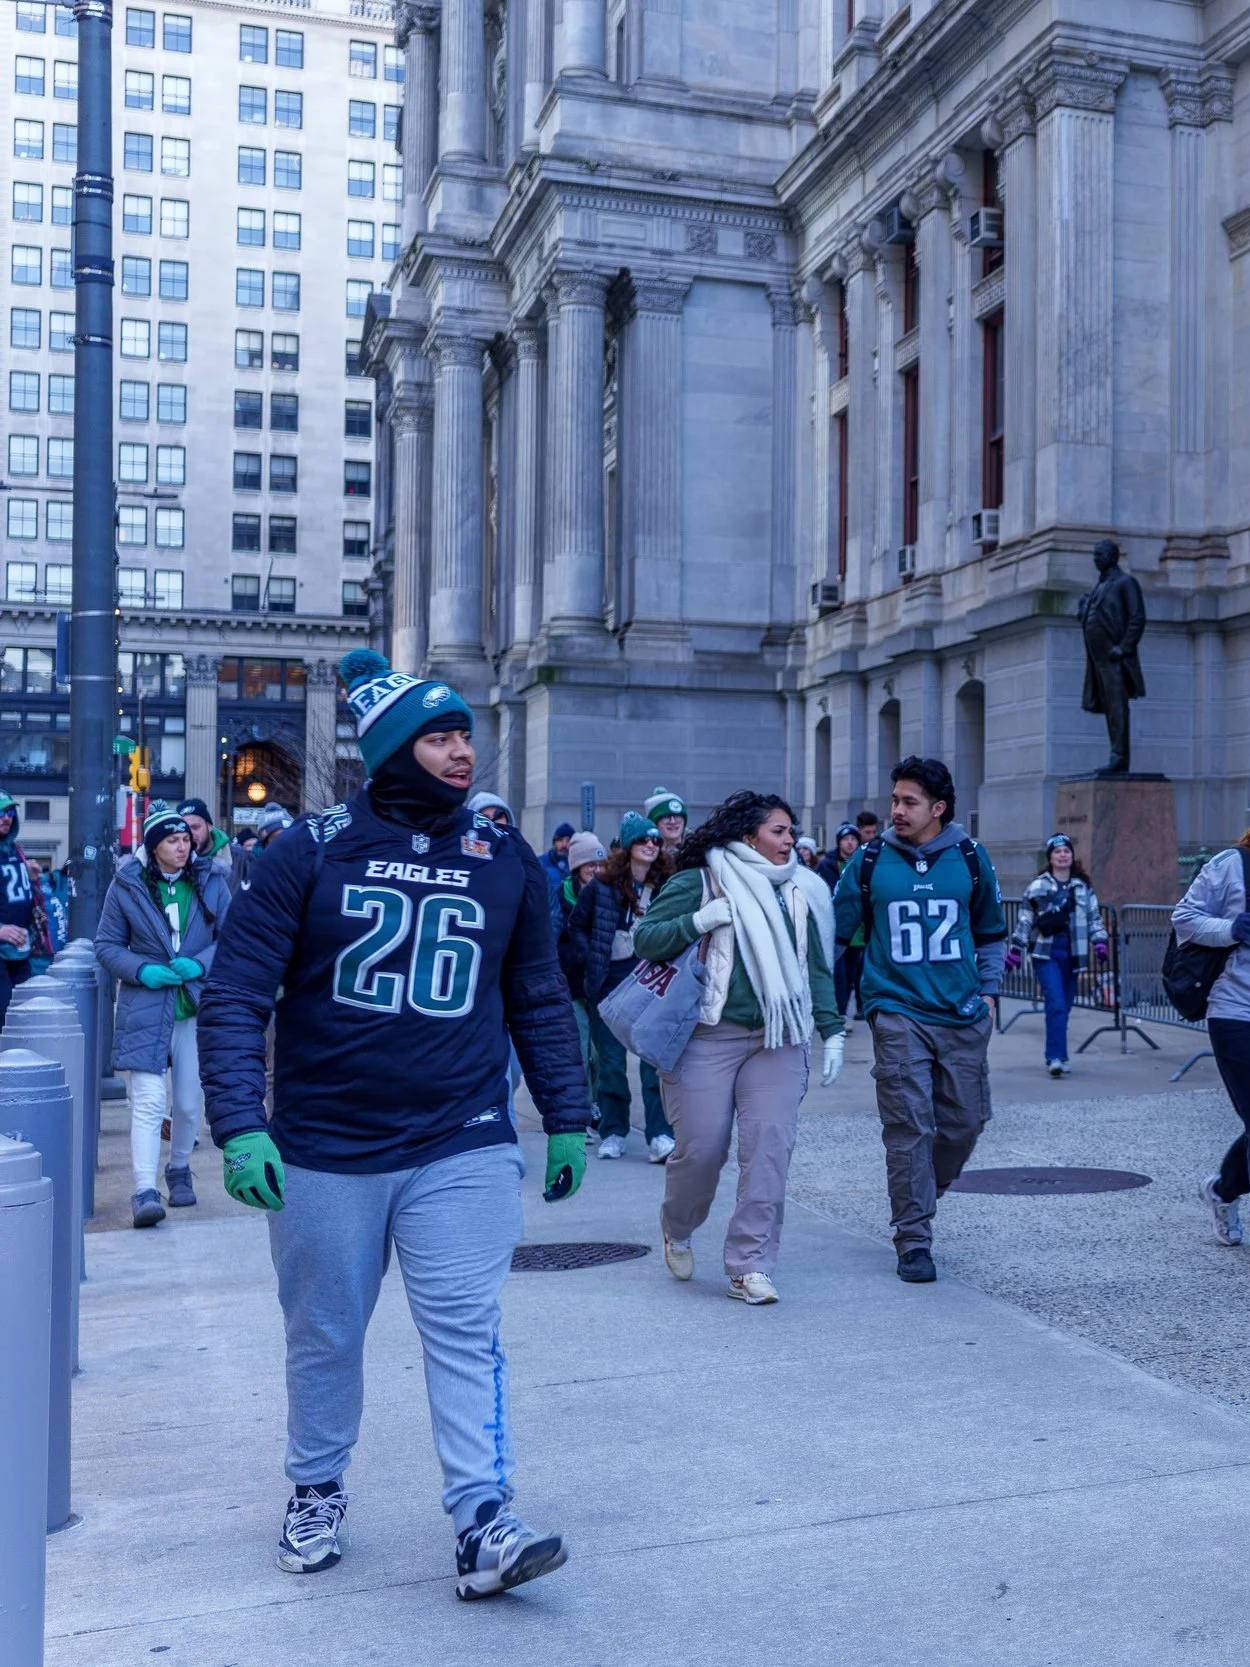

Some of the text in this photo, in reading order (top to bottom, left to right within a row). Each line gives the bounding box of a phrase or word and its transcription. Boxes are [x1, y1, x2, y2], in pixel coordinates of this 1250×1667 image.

[365, 860, 472, 888] EAGLES
[332, 884, 486, 1018] 26
[887, 898, 963, 965] 62
